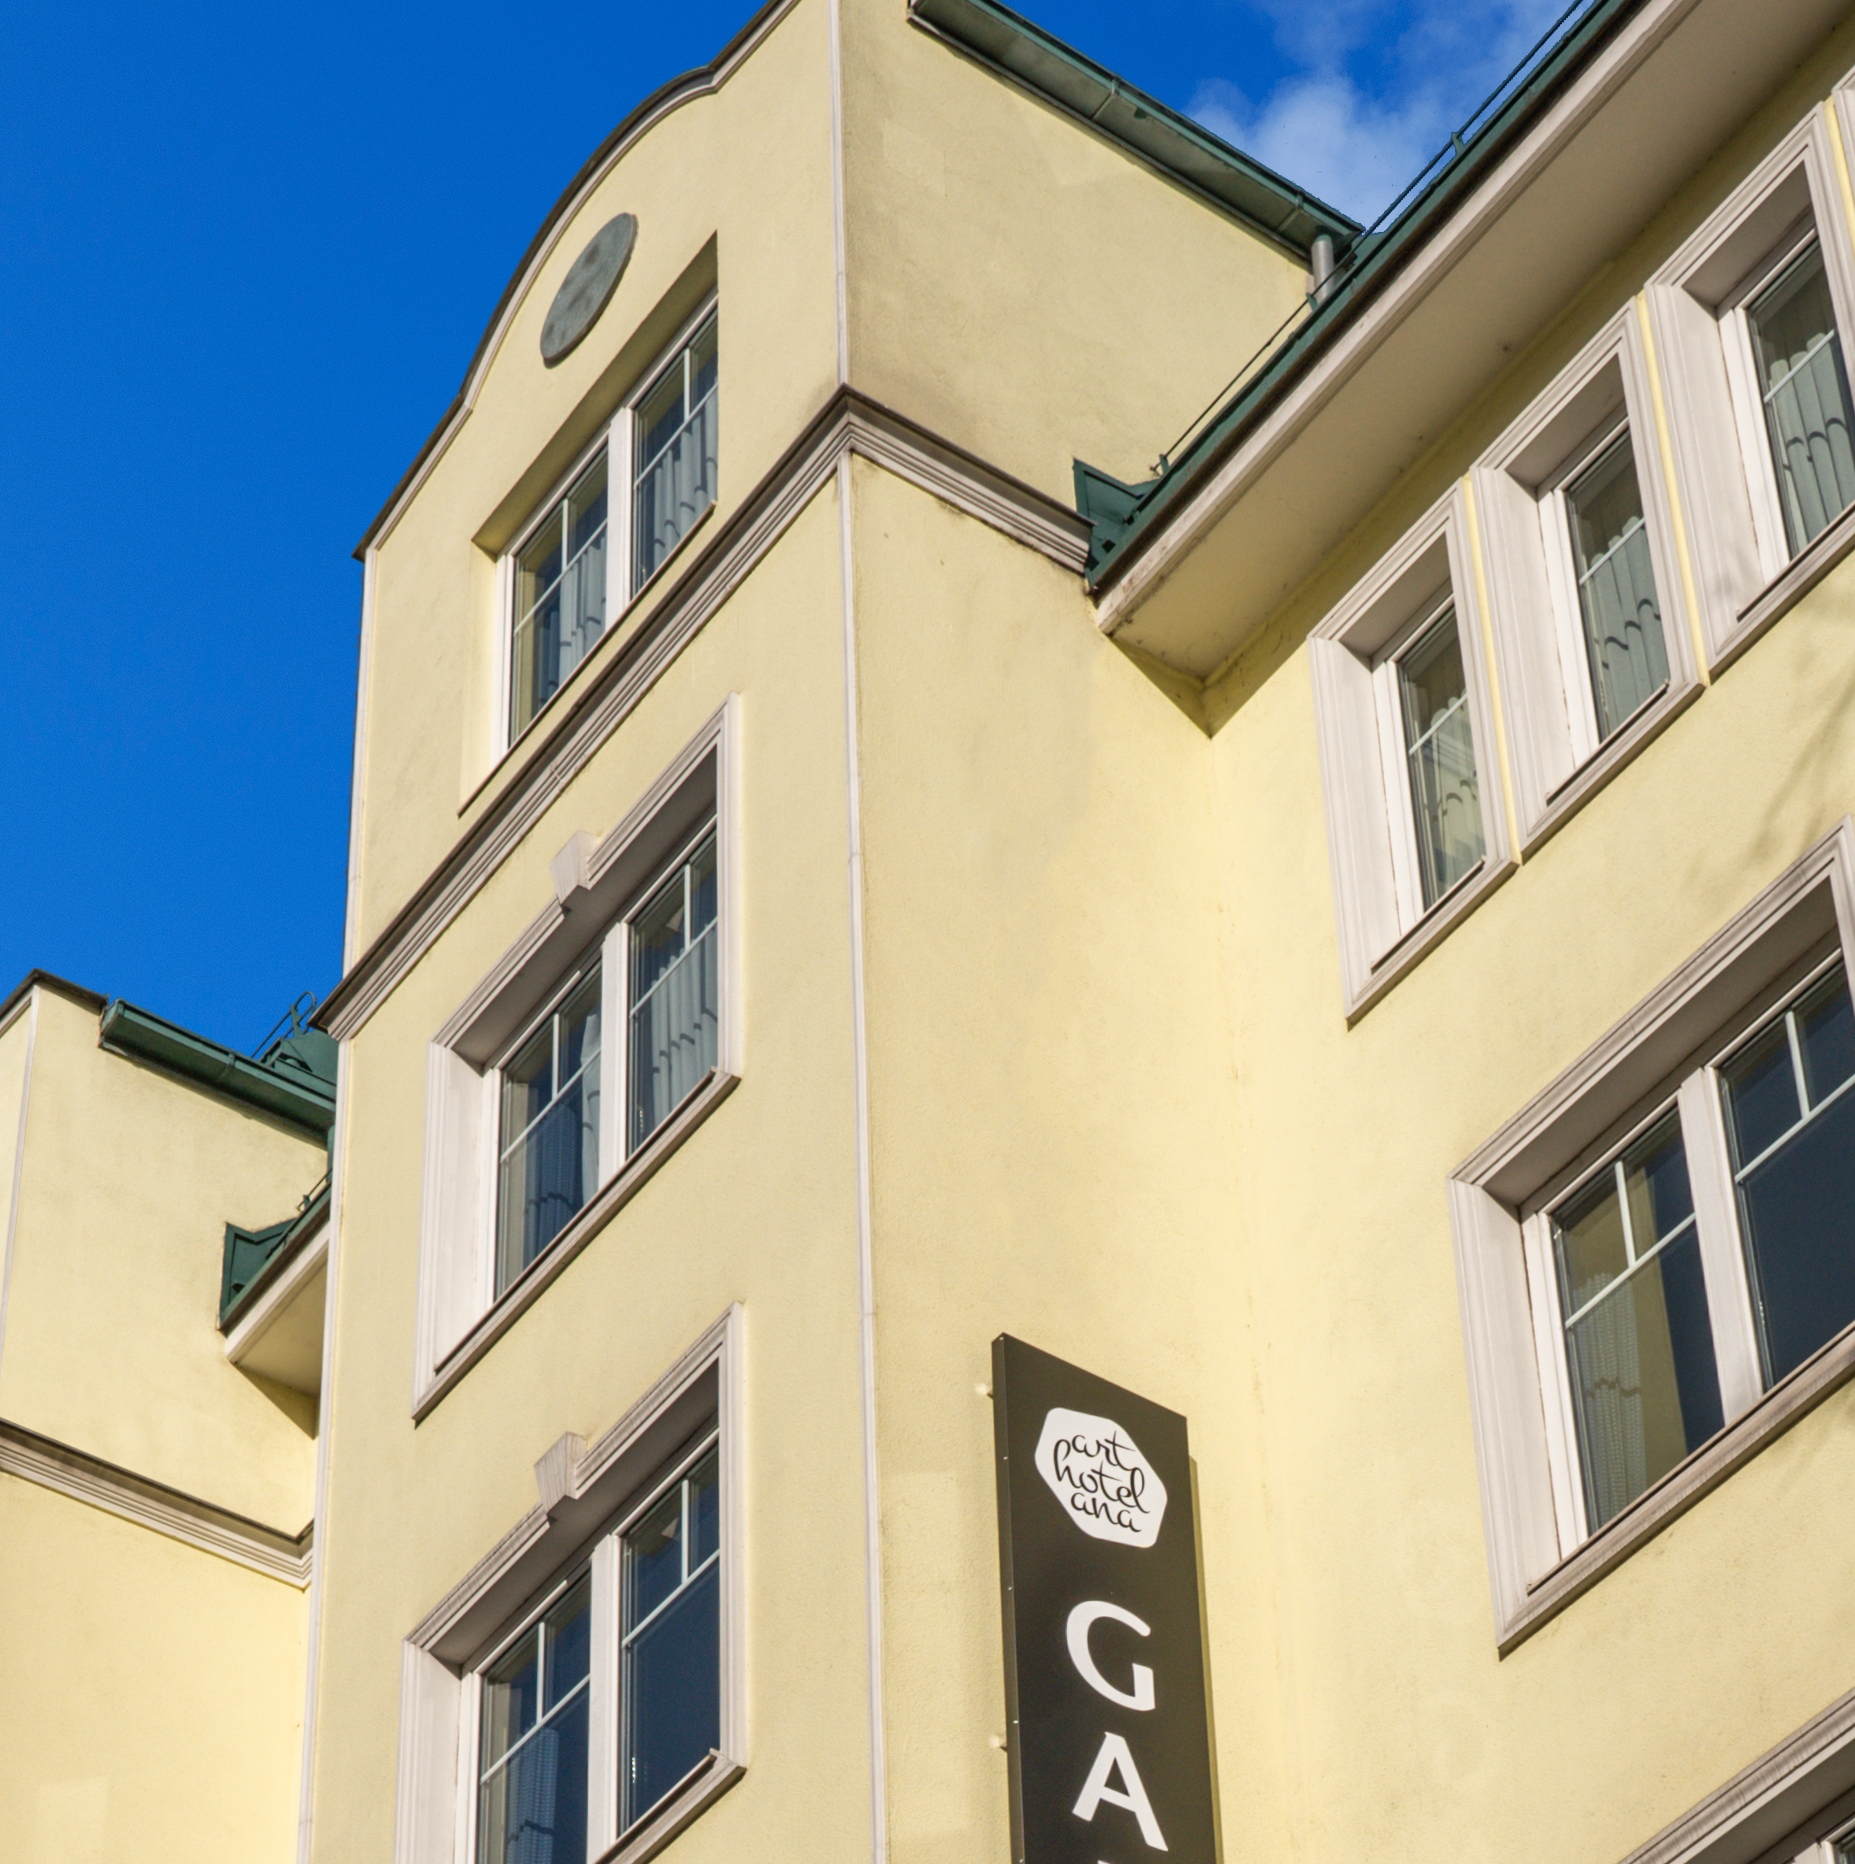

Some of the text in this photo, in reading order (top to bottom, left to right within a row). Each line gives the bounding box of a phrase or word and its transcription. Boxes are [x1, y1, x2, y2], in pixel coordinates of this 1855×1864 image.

[1071, 1429, 1136, 1471] art
[1053, 1438, 1151, 1514] hotel
[1070, 1492, 1142, 1533] ana
